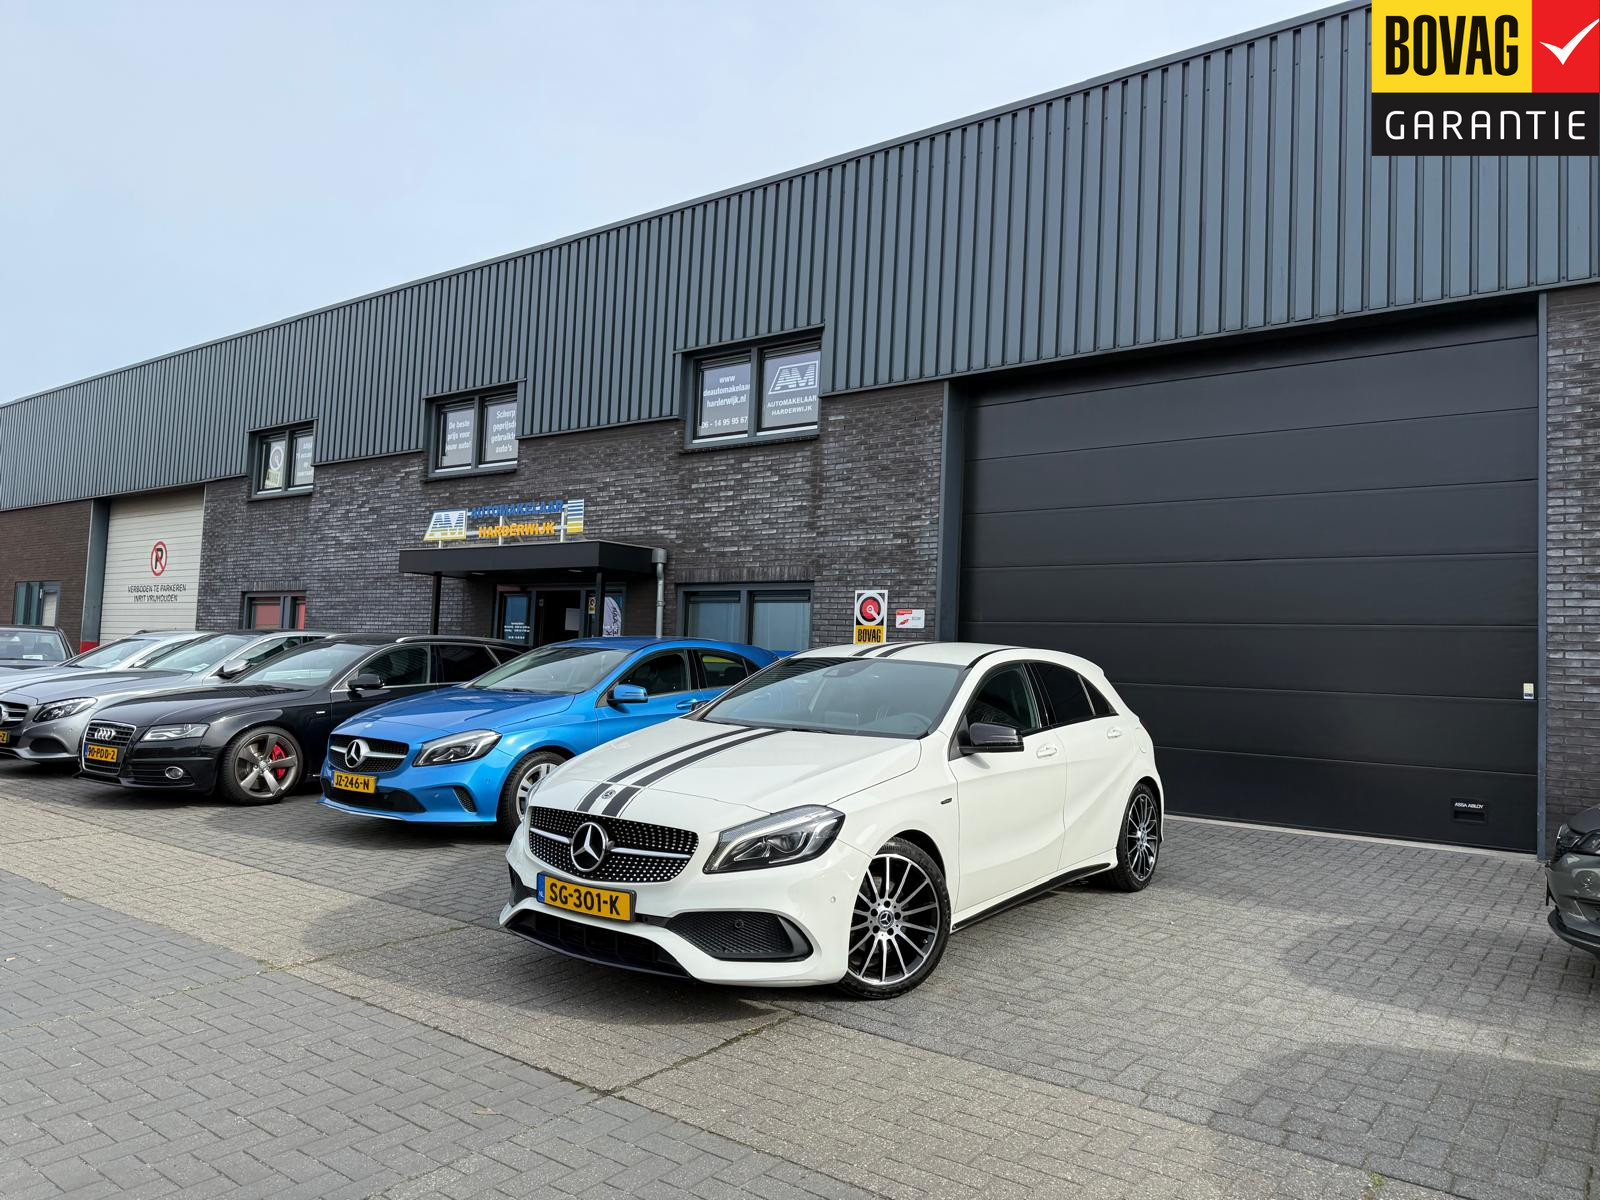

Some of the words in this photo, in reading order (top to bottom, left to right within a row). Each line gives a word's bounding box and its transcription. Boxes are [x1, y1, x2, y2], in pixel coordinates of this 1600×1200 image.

[719, 375, 736, 384] www
[706, 394, 747, 409] harderwijk.nl
[767, 394, 817, 408] AUTOMAKELAAR
[771, 404, 813, 416] HARDERWIJK
[470, 499, 564, 519] AUTOMAKELAAR
[478, 521, 555, 538] HARDERWIJK
[127, 585, 153, 593] VERBODEN
[153, 584, 160, 593] TE
[160, 583, 187, 593] PARKEREN
[857, 628, 882, 643] BOVAG
[335, 774, 370, 790] JZ-246-N
[549, 881, 620, 916] SG-301-K
